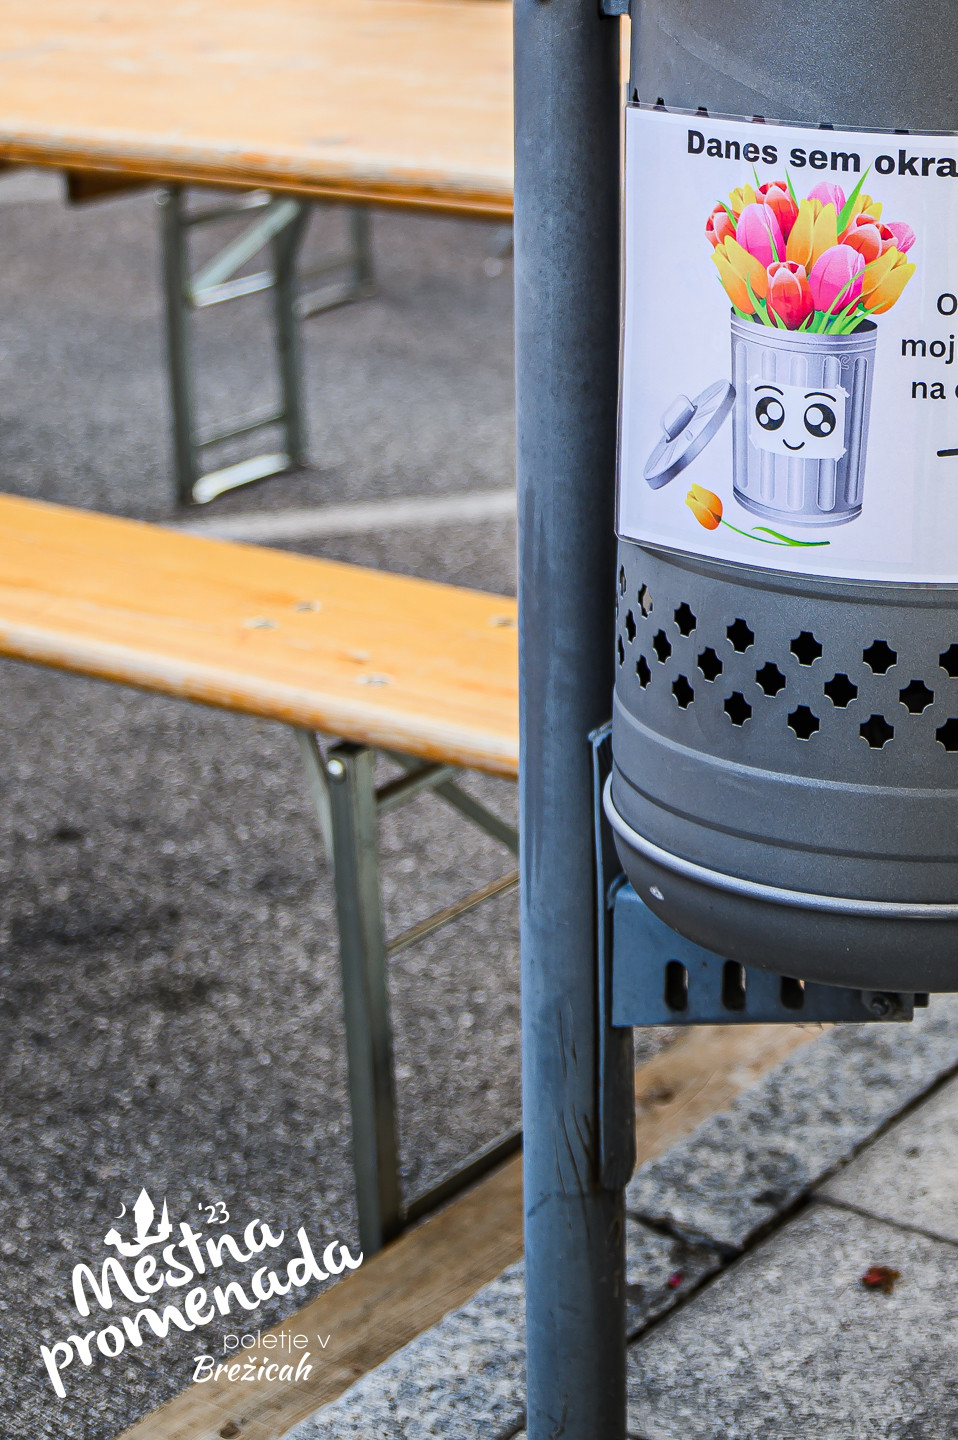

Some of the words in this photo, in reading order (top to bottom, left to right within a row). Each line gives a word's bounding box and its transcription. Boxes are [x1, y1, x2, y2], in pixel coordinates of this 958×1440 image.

[687, 129, 778, 165] Danes
[789, 148, 861, 173] sem
[911, 381, 947, 400] na
